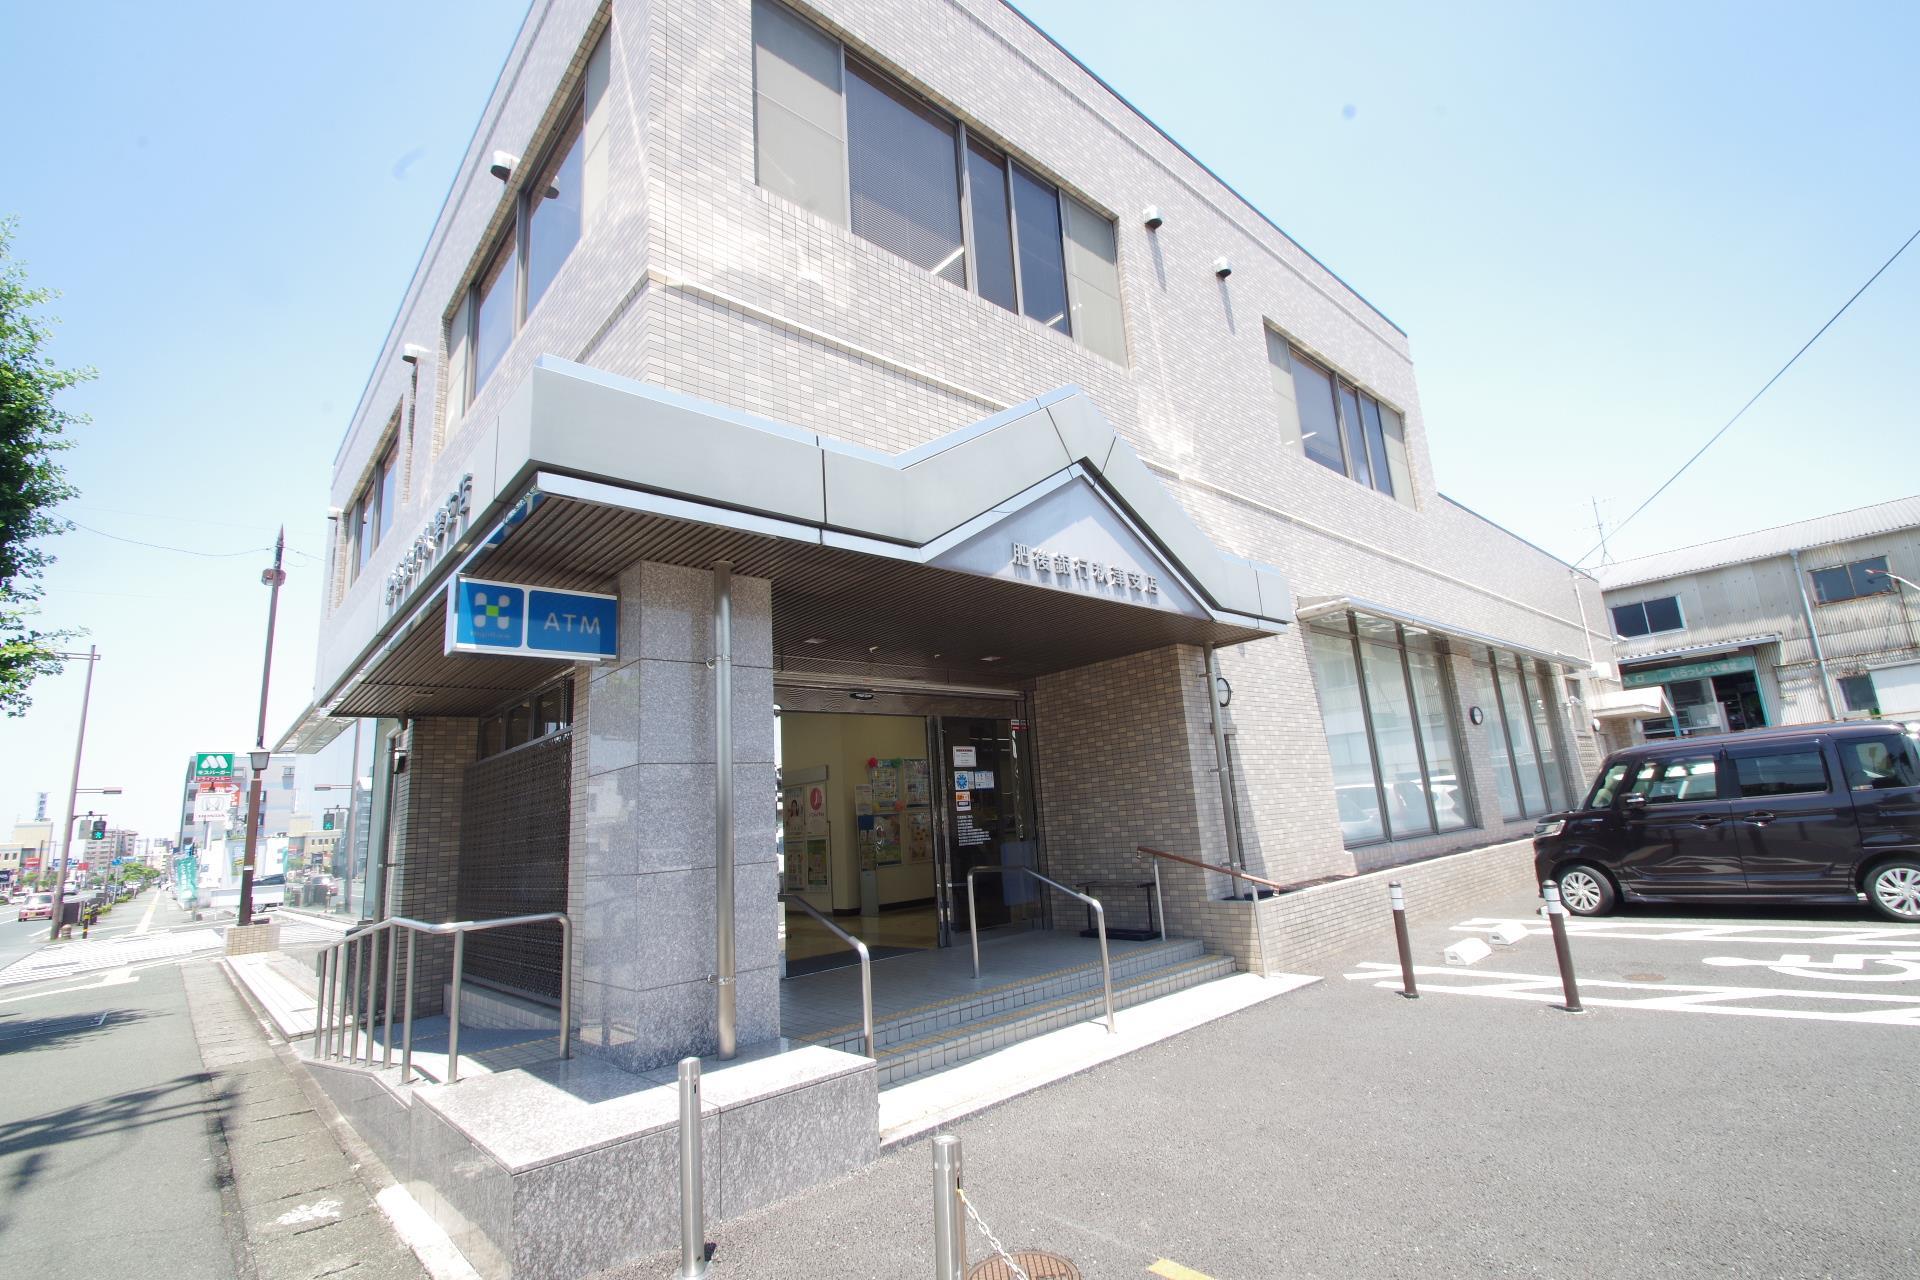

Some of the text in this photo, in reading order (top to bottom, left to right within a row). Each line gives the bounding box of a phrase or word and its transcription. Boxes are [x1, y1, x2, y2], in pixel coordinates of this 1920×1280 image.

[1009, 543, 1158, 595] 肥後銀行秋津支店
[544, 612, 601, 635] ATM
